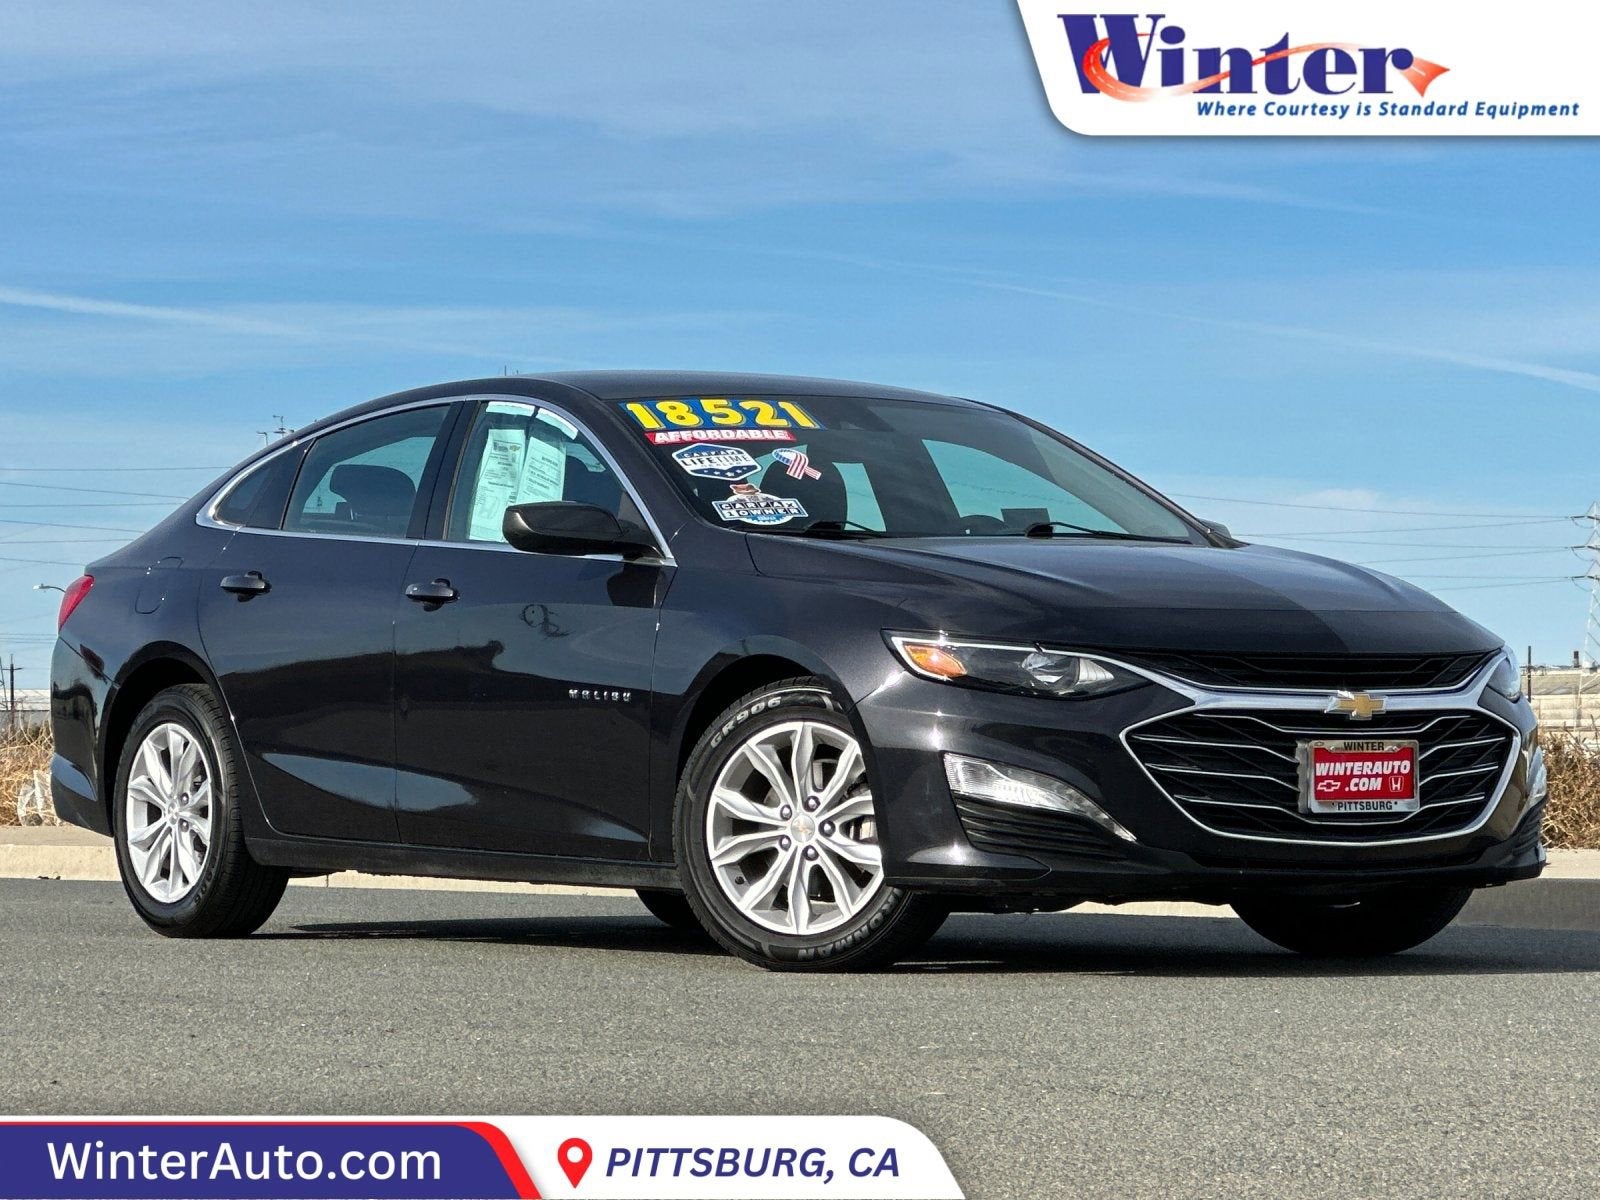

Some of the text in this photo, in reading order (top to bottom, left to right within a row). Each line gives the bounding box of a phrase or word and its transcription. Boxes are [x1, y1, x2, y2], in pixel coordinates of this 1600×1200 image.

[626, 398, 820, 429] 18521
[654, 429, 787, 443] AFFORDABLE
[681, 455, 750, 466] LIFETIME
[721, 501, 797, 510] CARFAX
[739, 507, 800, 516] OWNER
[710, 696, 782, 748] GR906
[1343, 741, 1385, 751] WINTER
[1315, 760, 1411, 776] WINTERAUTO
[1344, 777, 1383, 792] .COM
[1337, 800, 1393, 811] PITTSBURG
